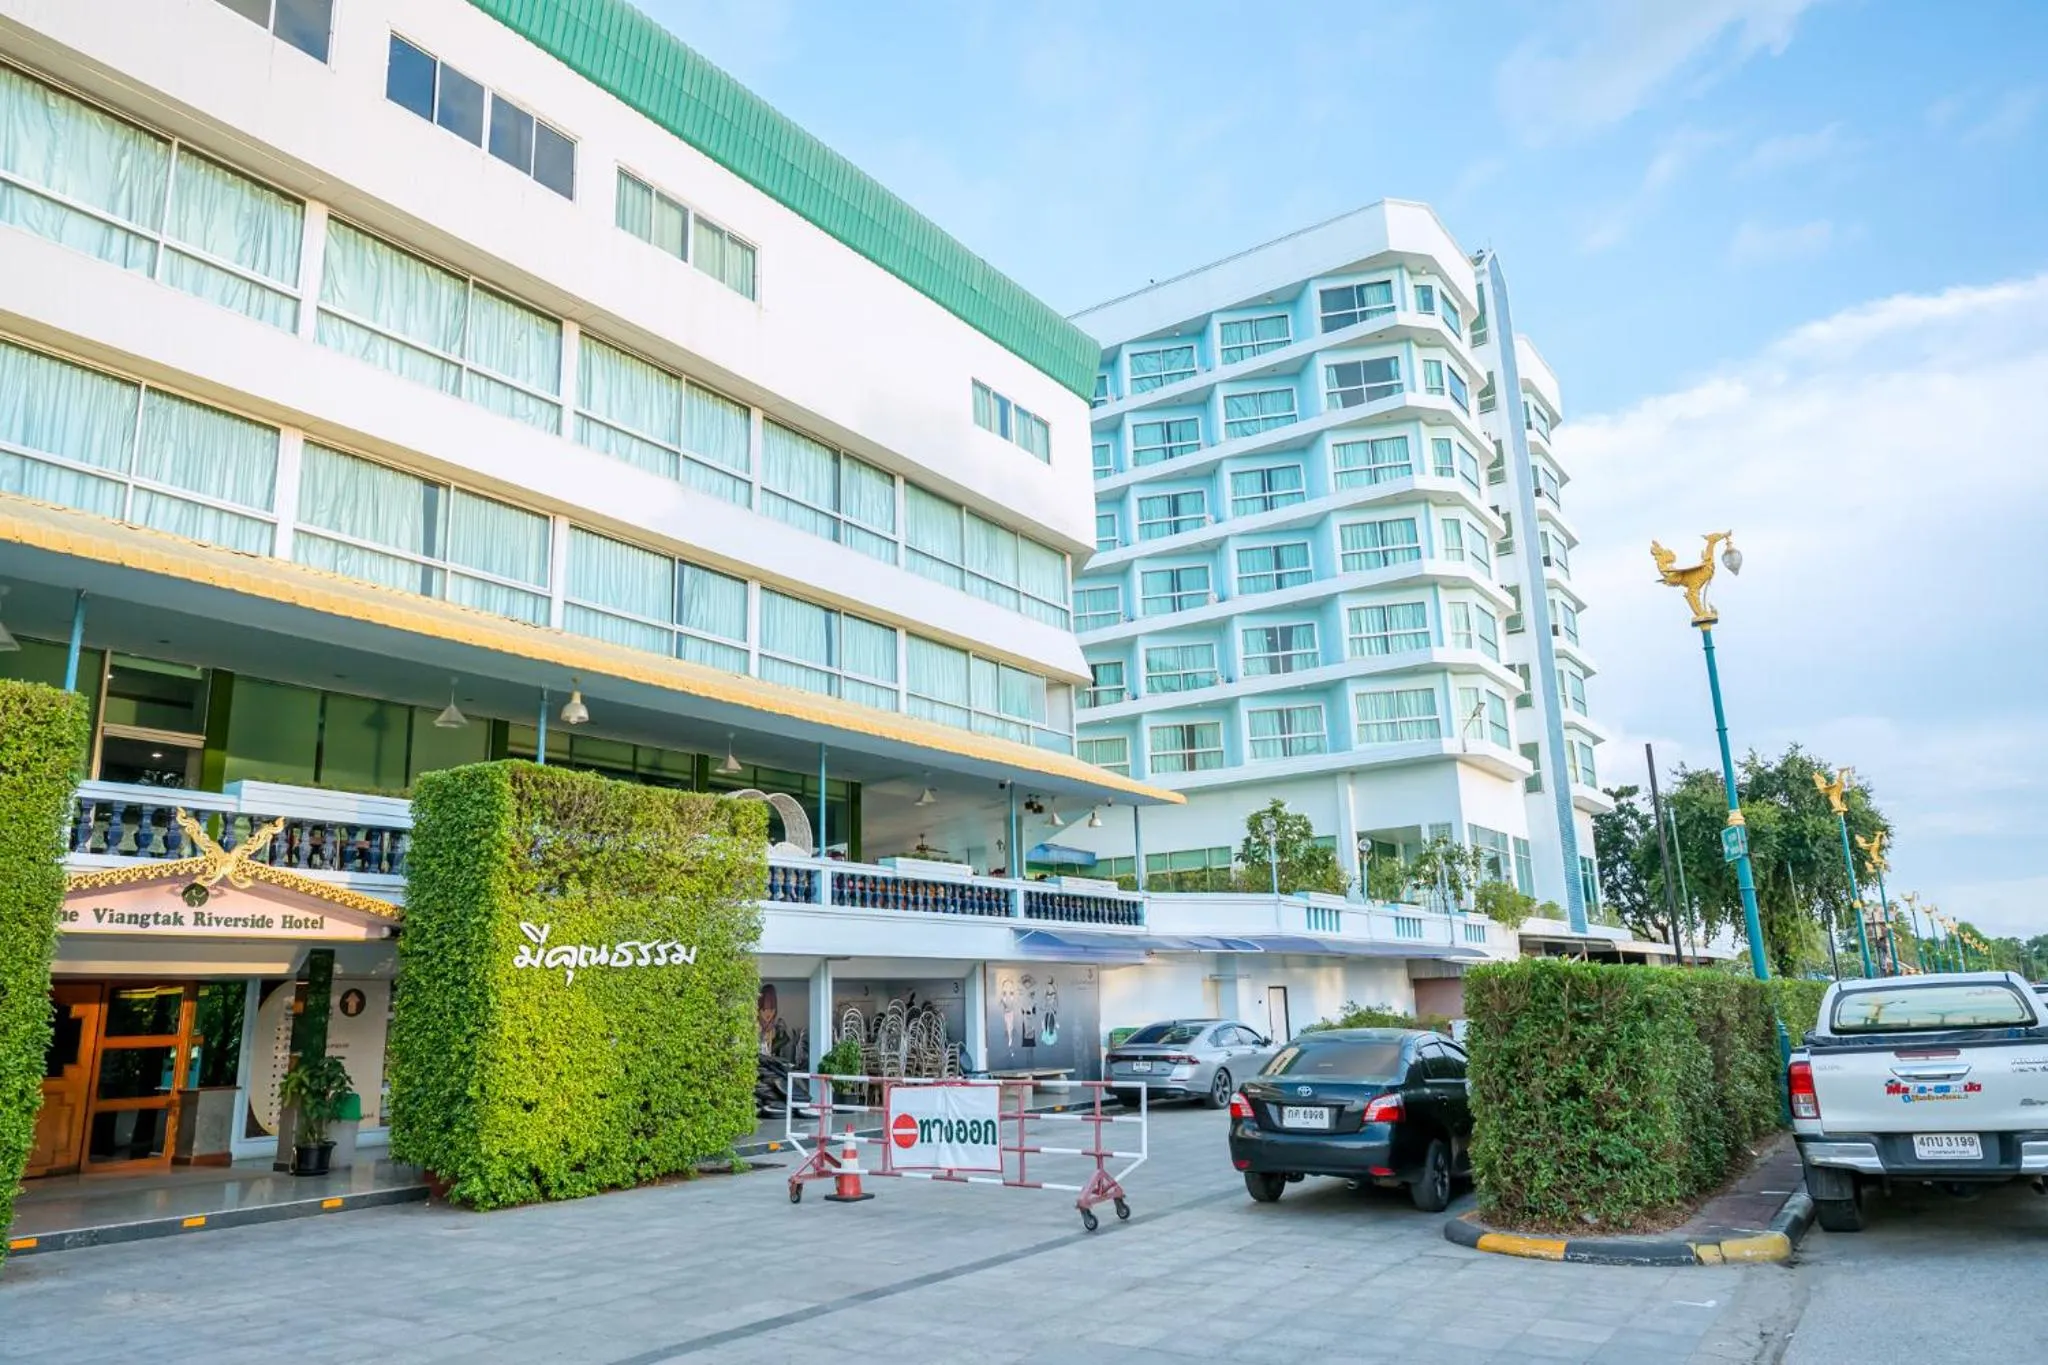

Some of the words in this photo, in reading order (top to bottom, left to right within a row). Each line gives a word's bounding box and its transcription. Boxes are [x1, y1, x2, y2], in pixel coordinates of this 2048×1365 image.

[61, 909, 79, 922] he
[93, 908, 184, 928] Viangtak
[193, 911, 274, 928] Riverside
[281, 914, 325, 930] Hotel
[513, 921, 697, 987] มีคุณธรรม
[919, 1118, 997, 1146] ทางออก
[1946, 1136, 1975, 1148] 3199
